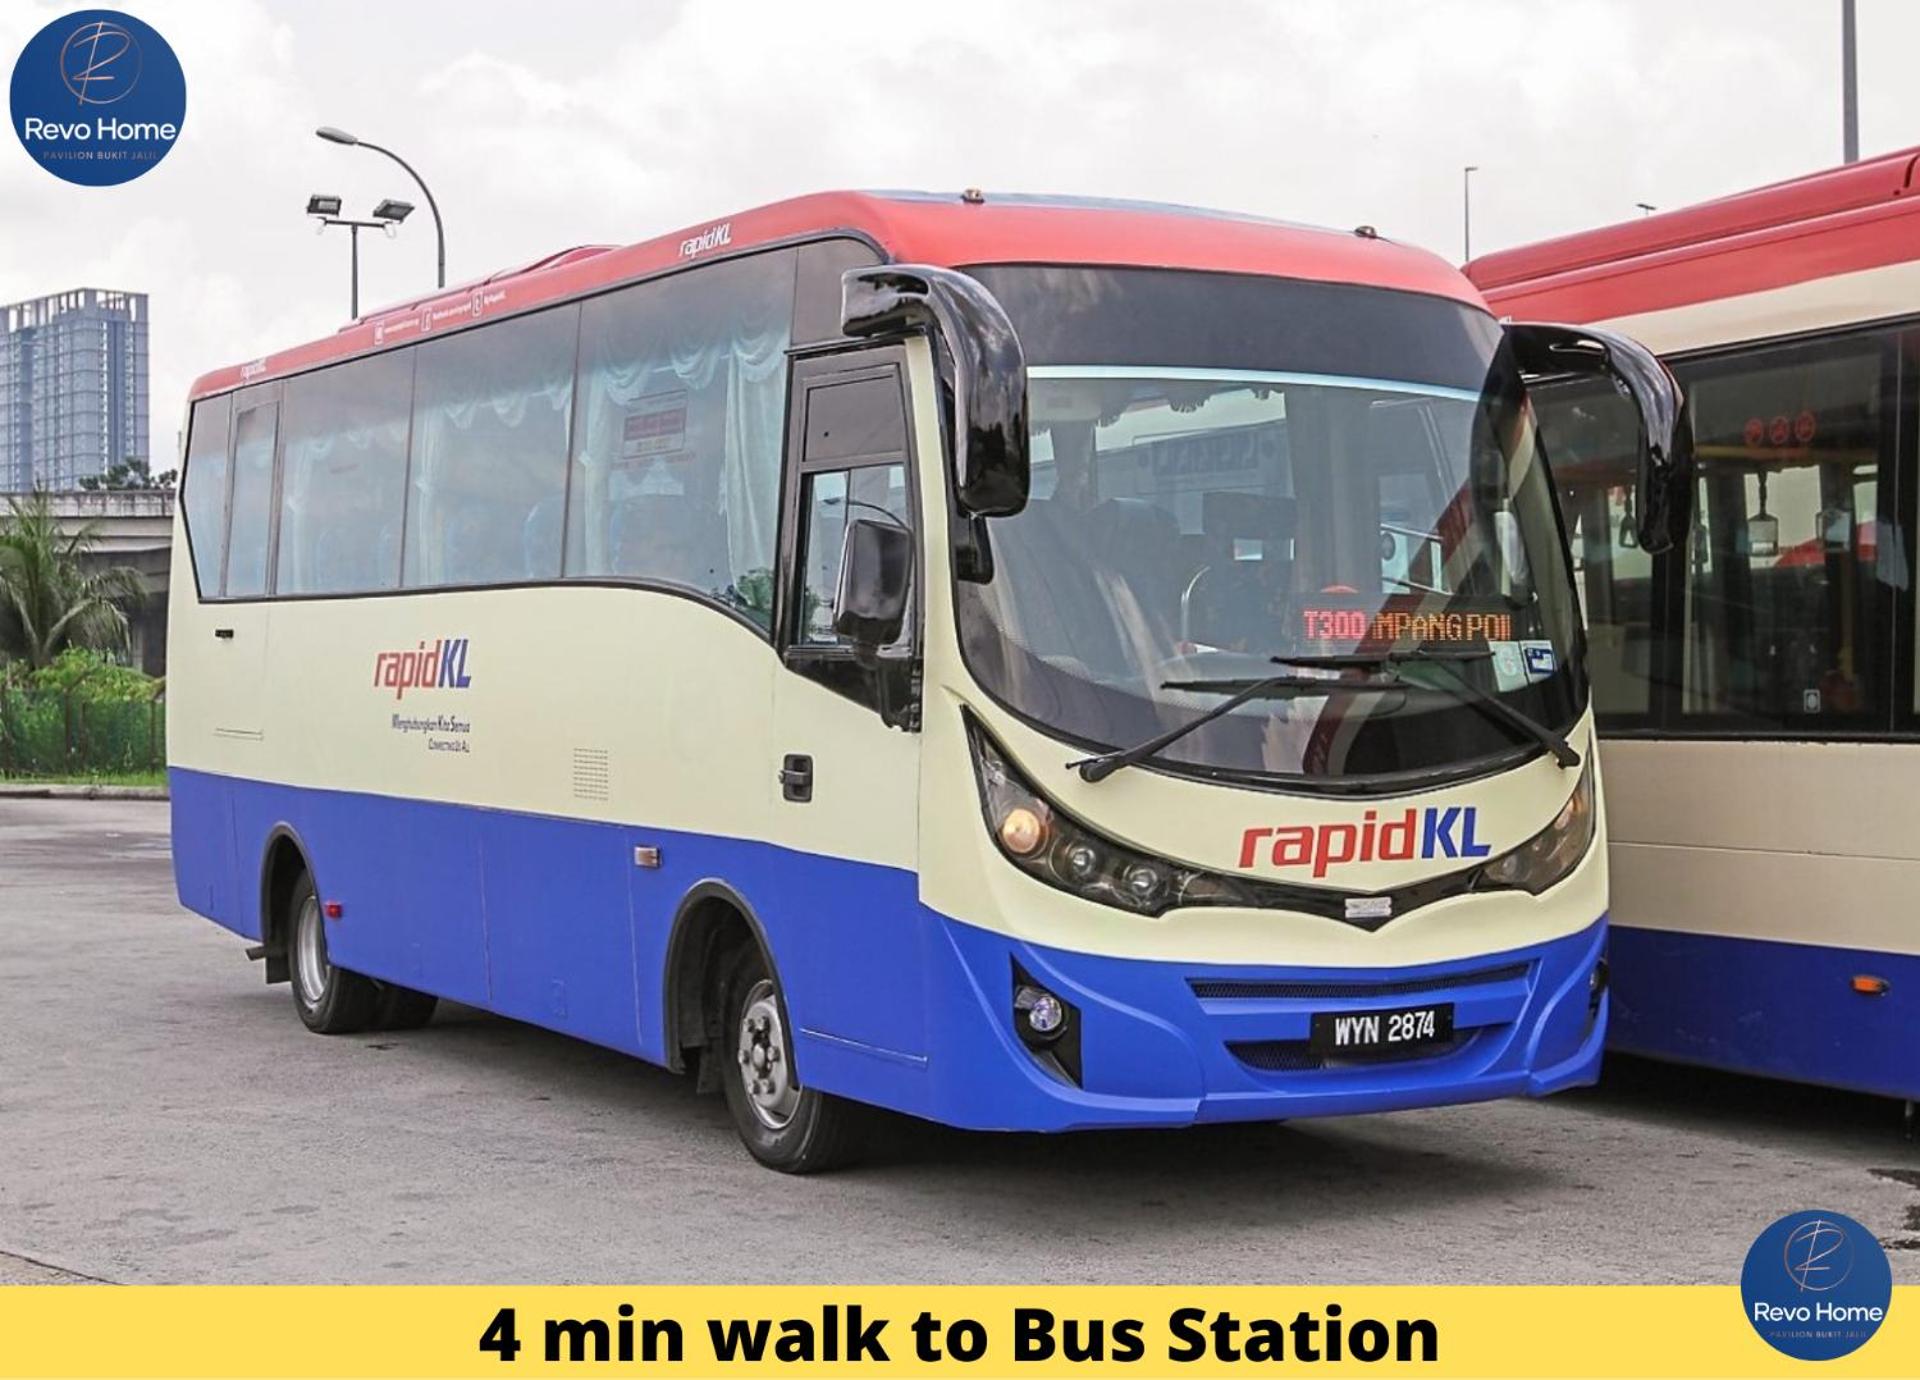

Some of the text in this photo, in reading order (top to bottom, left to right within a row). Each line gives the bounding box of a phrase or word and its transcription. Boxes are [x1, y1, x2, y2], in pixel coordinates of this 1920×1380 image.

[1304, 610, 1365, 640] T300
[374, 639, 471, 700] rapidKL
[1239, 807, 1492, 878] rapidKL
[1335, 1010, 1435, 1046] WYN 2874
